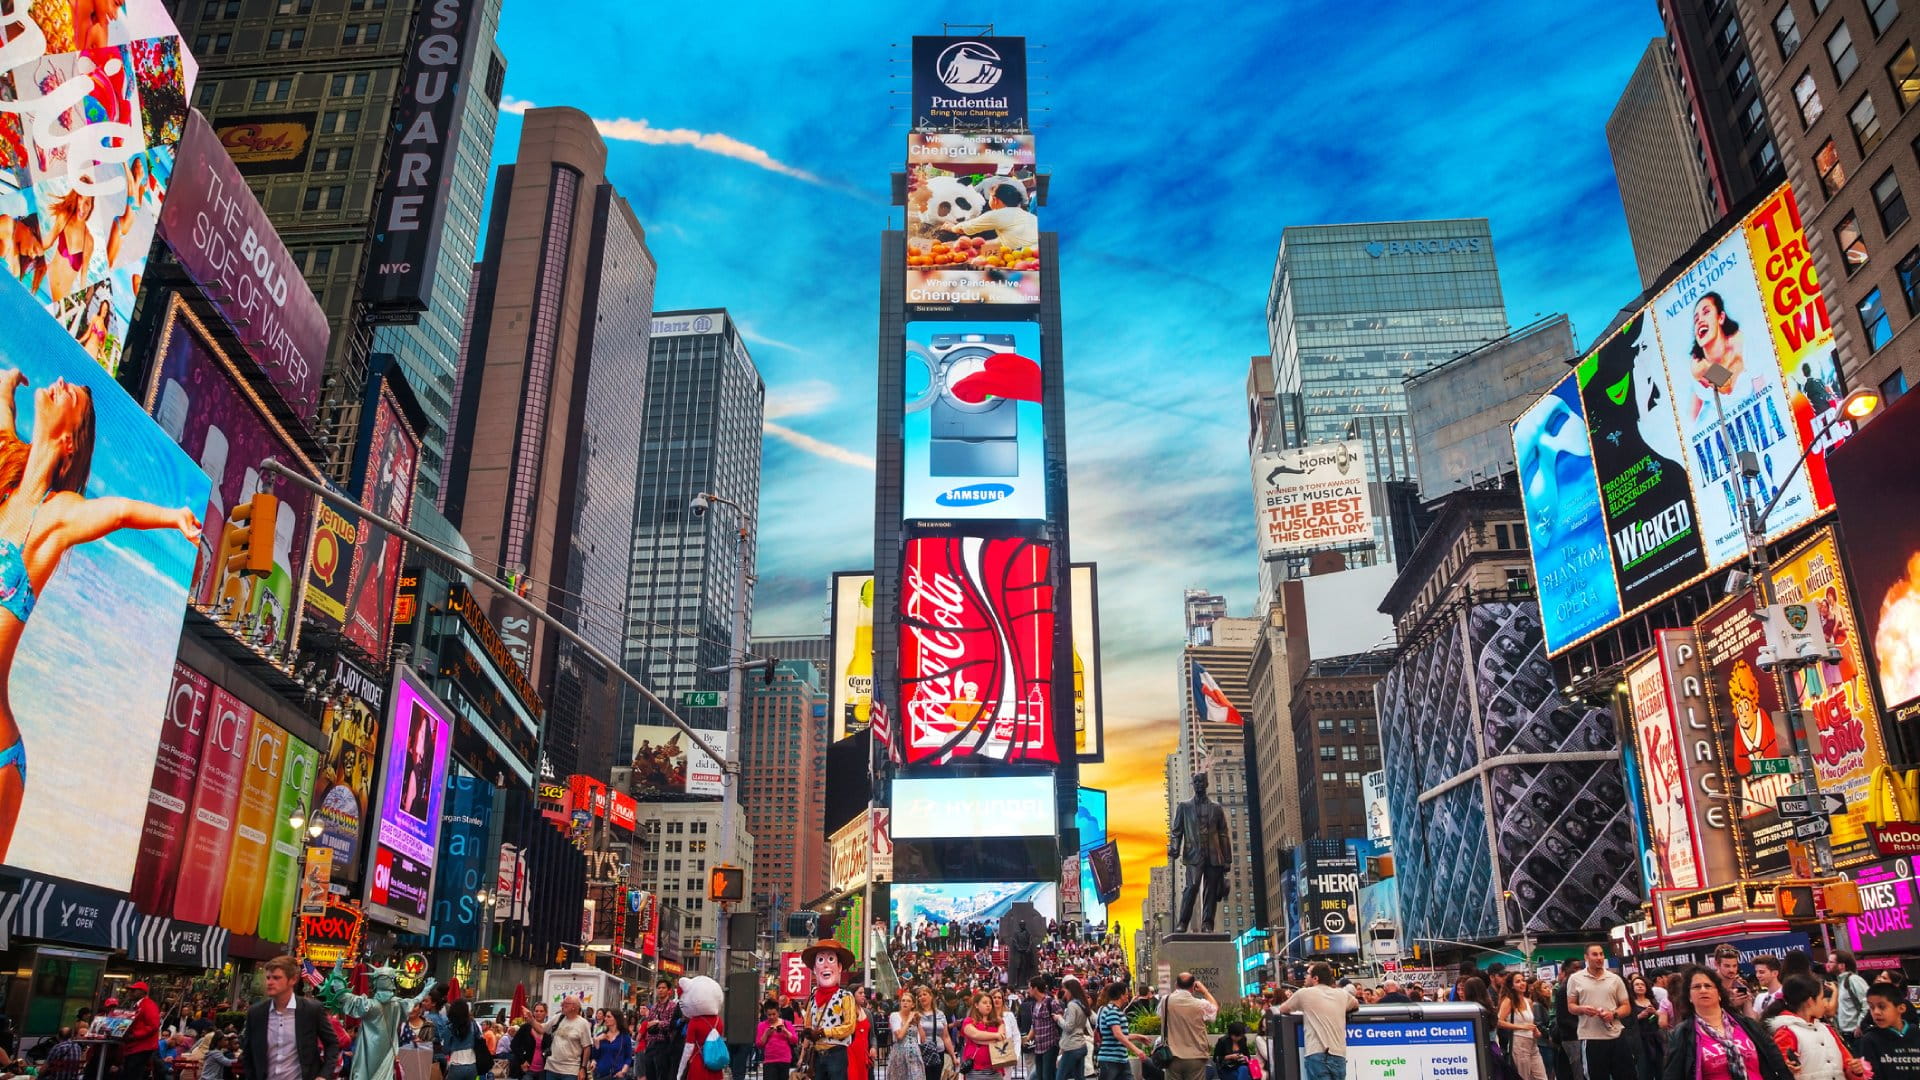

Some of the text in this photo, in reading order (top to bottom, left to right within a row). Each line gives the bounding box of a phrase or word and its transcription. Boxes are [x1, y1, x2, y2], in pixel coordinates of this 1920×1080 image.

[932, 96, 1008, 109] Prudential
[388, 0, 459, 231] SQUARE
[969, 110, 1008, 118] Challenges
[206, 164, 288, 307] THE BOLD
[1389, 238, 1479, 256] BARCLAYS
[379, 263, 411, 274] NYC
[1676, 251, 1719, 294] THE FUN
[1666, 252, 1737, 319] NEVER STOPS!
[192, 211, 309, 392] SIDE OF WATER
[910, 289, 985, 303] Chengdu,
[1694, 395, 1787, 488] MAMMA
[946, 490, 1005, 500] SAMSUNG
[1266, 486, 1297, 495] WINNER
[1305, 482, 1327, 490] TONY
[1327, 478, 1360, 487] AWARDS
[1608, 476, 1638, 503] BIGGEST
[1267, 487, 1361, 506] BEST MUSICAL
[1312, 497, 1362, 515] BEST
[1269, 511, 1365, 534] MUSICAL OF
[1271, 531, 1300, 544] THIS
[312, 526, 338, 587] Q
[1543, 542, 1605, 593] PHANTOM
[1806, 566, 1834, 593] MUELLER
[1556, 591, 1600, 622] OPERA
[1707, 627, 1735, 650] FEEL-GOOD
[1717, 627, 1750, 653] IS BACK AND
[907, 564, 965, 742] Coca-Cola
[1712, 640, 1744, 666] BETTER THAN
[336, 661, 383, 707] A JOY RIDE!
[1638, 673, 1657, 700] CAUSE
[165, 676, 205, 736] ICE
[695, 694, 705, 705] 46
[1812, 690, 1852, 732] NICE
[211, 703, 246, 760] ICE
[704, 734, 714, 744] By
[1677, 644, 1726, 829] PALACE
[252, 728, 281, 777] ICE
[286, 748, 312, 797] ICE
[696, 760, 709, 769] did
[1753, 759, 1786, 774] W 46 ST
[1826, 767, 1837, 779] You
[1837, 764, 1848, 777] Can
[1847, 759, 1857, 772] Get
[162, 796, 184, 811] CALORIES
[1741, 774, 1793, 818] Annie
[1784, 802, 1803, 811] ONE
[321, 806, 358, 829] MOTOWN
[441, 815, 483, 827] organ Stanley
[1800, 825, 1810, 835] ONE
[1879, 832, 1920, 843] McDo
[376, 864, 390, 890] CNN
[1319, 873, 1358, 893] HERO
[78, 905, 99, 918] WE'RE
[1321, 900, 1347, 910] JUNE 6
[1697, 895, 1715, 914] Annie
[75, 917, 94, 928] OPEN
[309, 916, 355, 940] ROXY
[1857, 906, 1913, 937] SQUARE
[183, 931, 201, 943] WE'RE
[181, 944, 197, 955] OPEN
[1645, 954, 1690, 969] BOX OFFICE HERE
[788, 957, 806, 994] tkts
[1190, 967, 1219, 977] GEORGE
[1366, 1028, 1401, 1038] Green
[1406, 1027, 1427, 1037] and
[1430, 1026, 1467, 1037] Clean!
[1370, 1057, 1406, 1066] recycle
[1431, 1055, 1468, 1066] recycle
[1383, 1068, 1396, 1077] all
[1433, 1067, 1469, 1075] bottles
